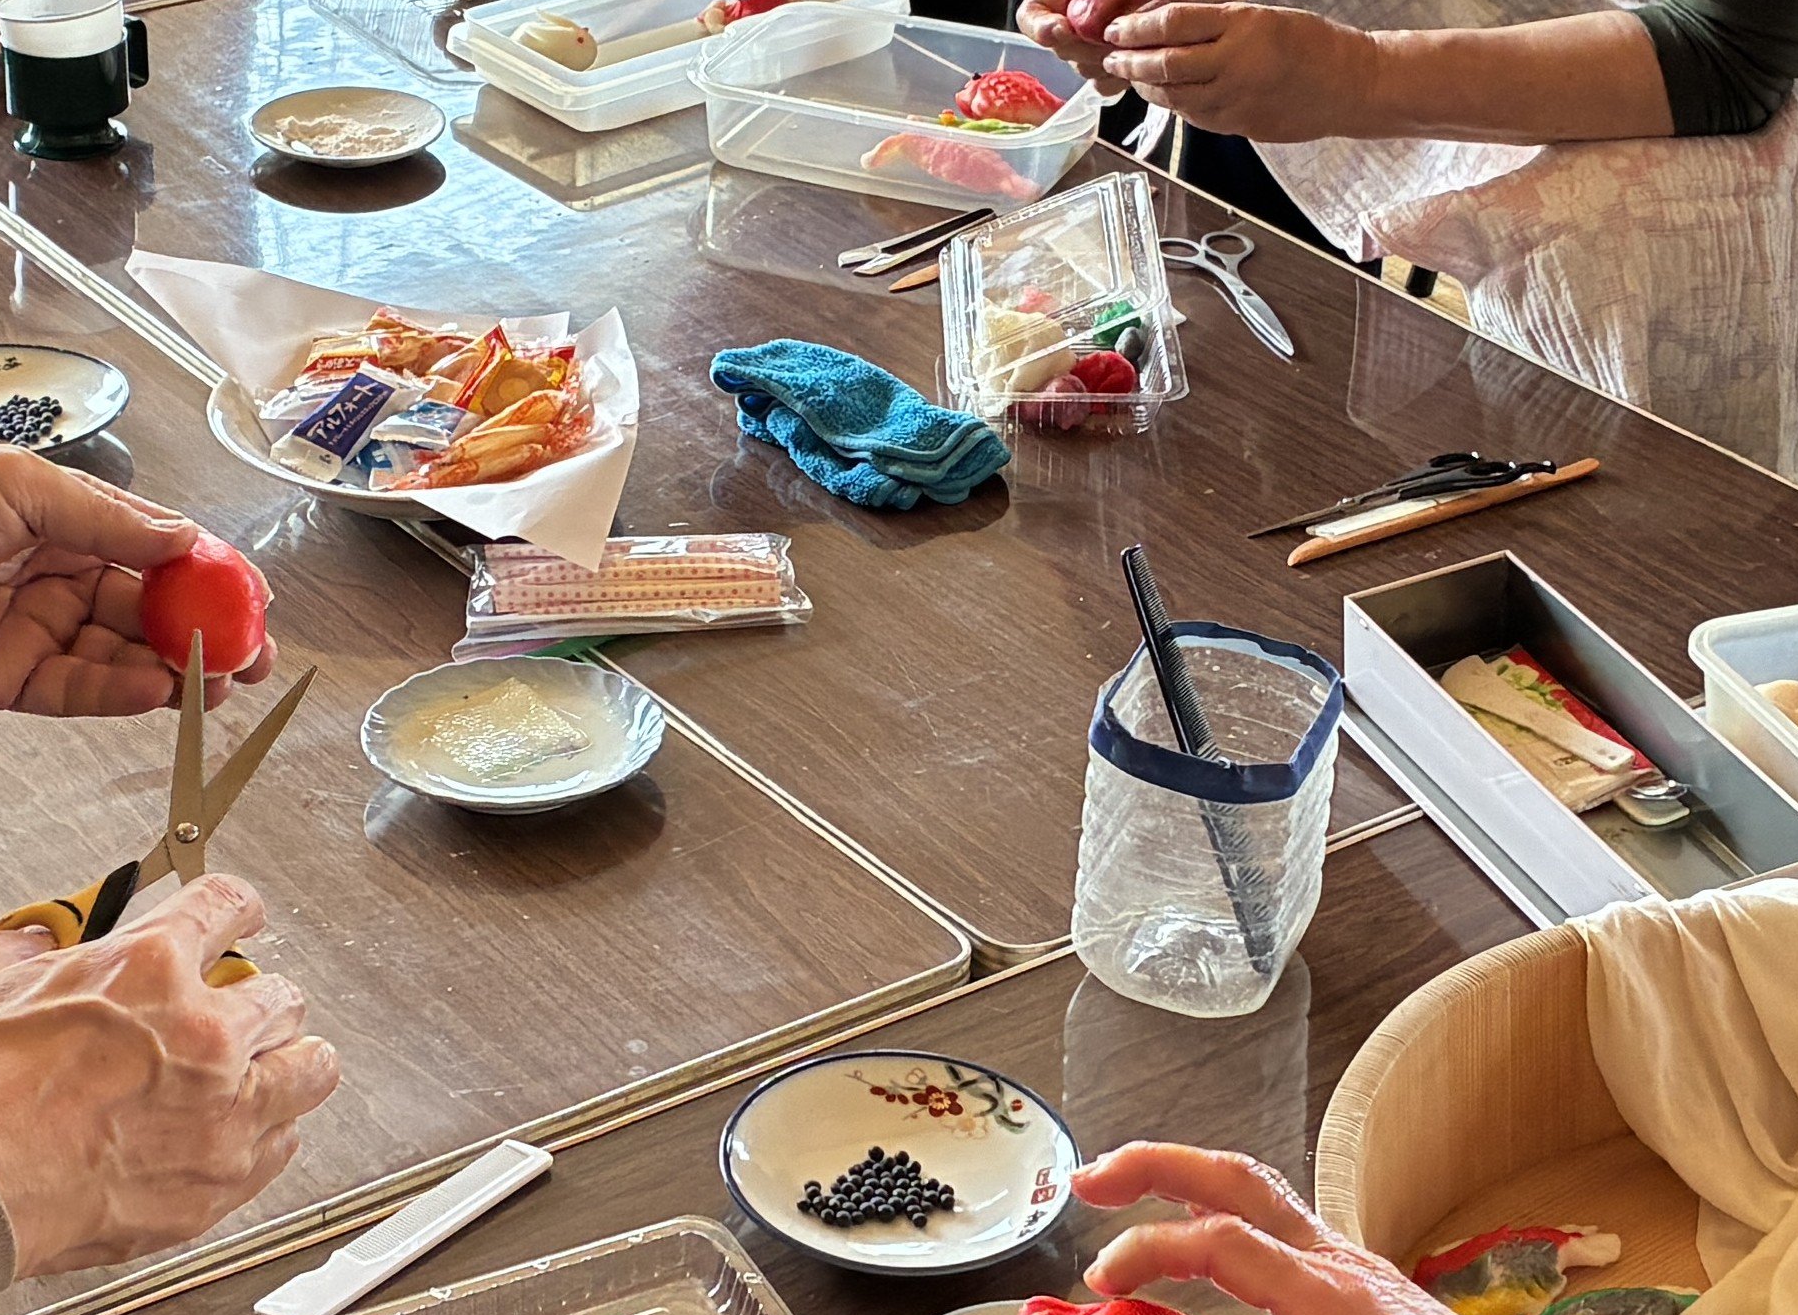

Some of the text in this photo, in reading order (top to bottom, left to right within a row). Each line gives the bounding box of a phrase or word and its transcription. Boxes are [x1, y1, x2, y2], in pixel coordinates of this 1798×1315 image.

[306, 381, 380, 441] アルフォート
